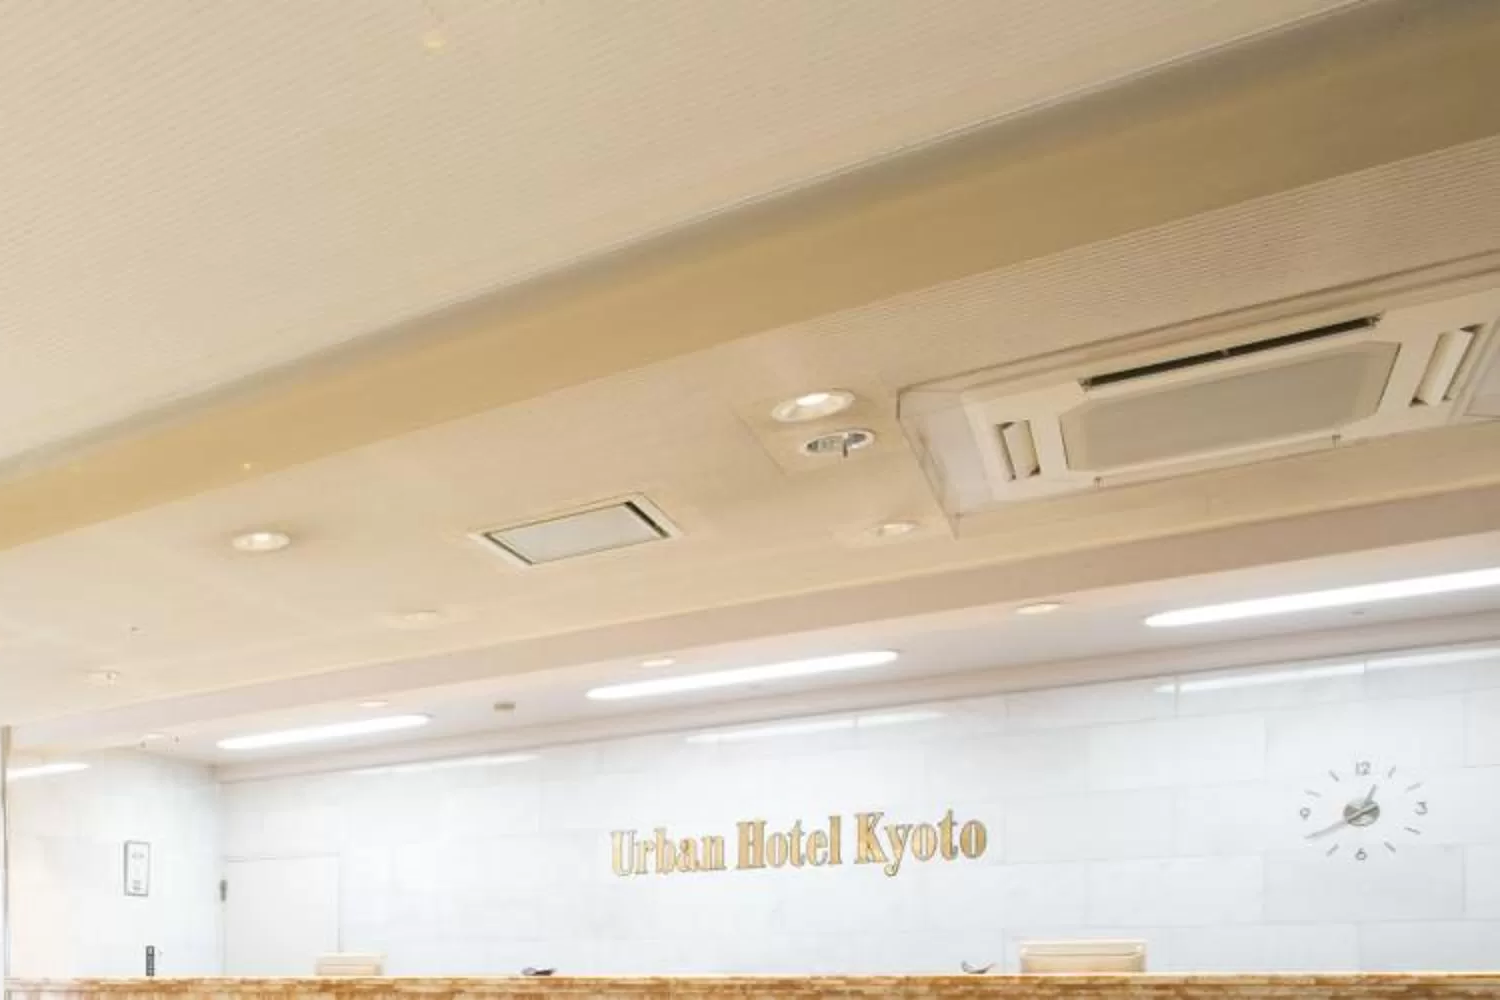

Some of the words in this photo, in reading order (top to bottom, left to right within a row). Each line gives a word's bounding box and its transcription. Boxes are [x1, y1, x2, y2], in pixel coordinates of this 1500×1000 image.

[1355, 761, 1371, 776] 12
[1300, 807, 1311, 820] 9
[1415, 801, 1428, 816] 3
[610, 828, 727, 876] Urban
[736, 815, 843, 869] Hotel
[854, 809, 988, 877] Kyoto
[1355, 848, 1368, 861] 6
